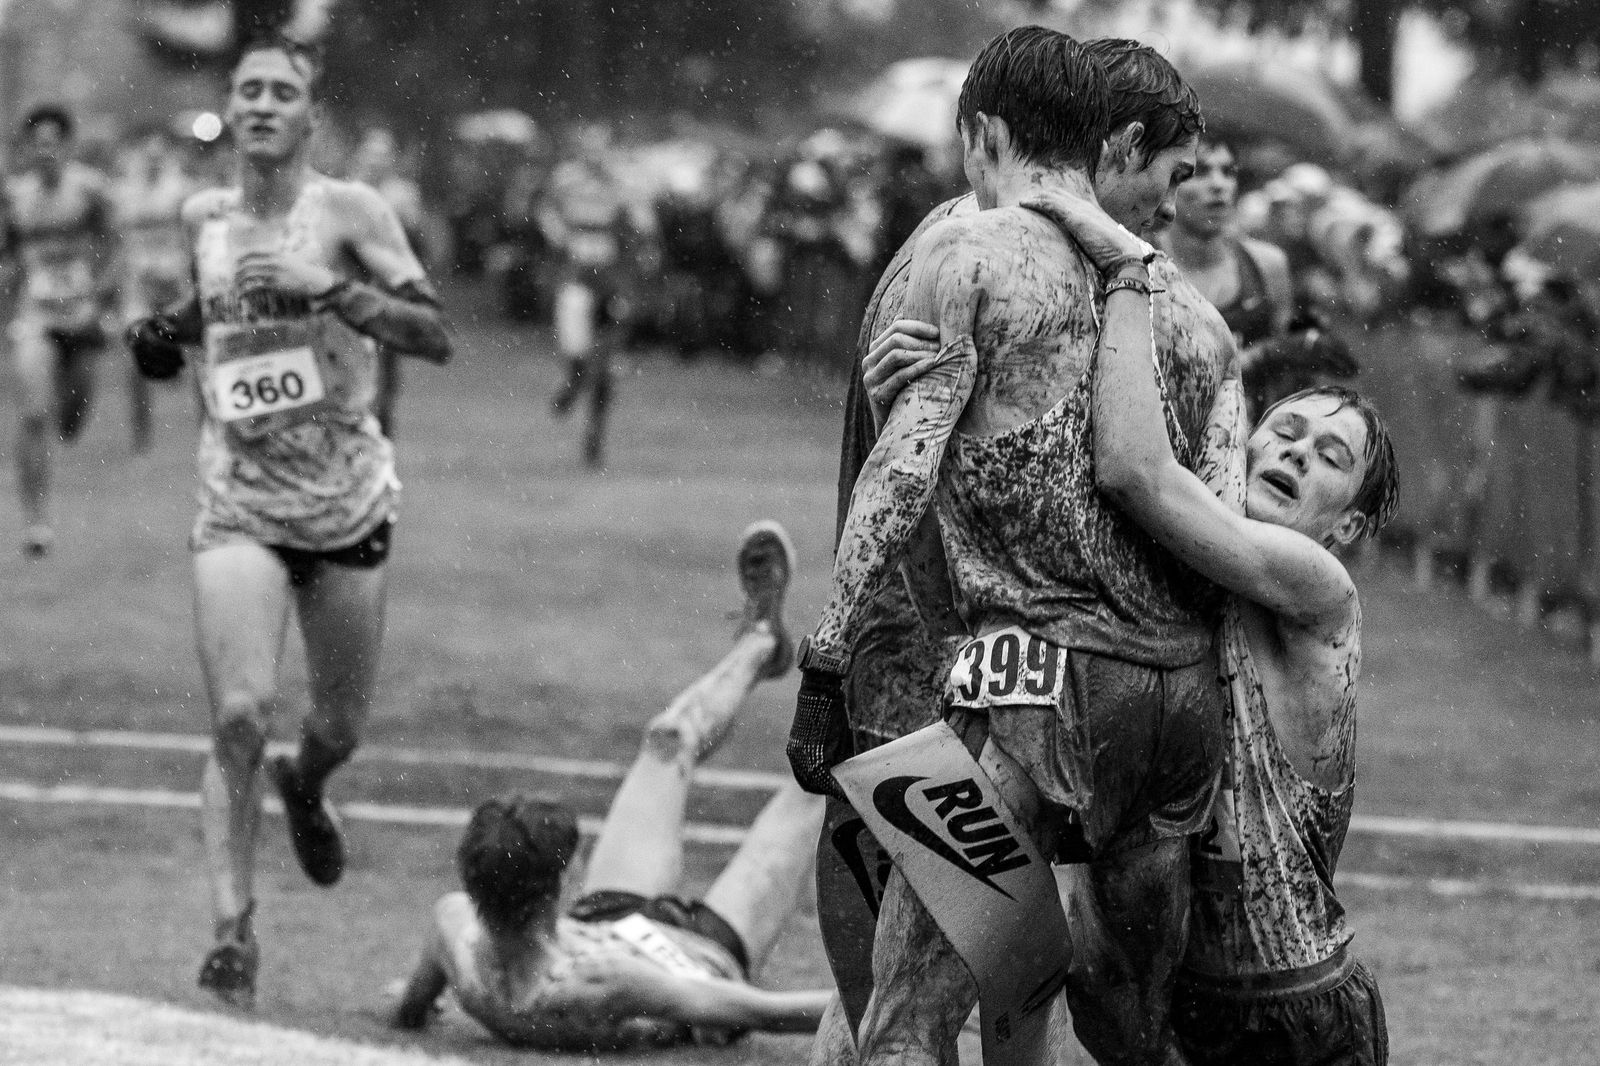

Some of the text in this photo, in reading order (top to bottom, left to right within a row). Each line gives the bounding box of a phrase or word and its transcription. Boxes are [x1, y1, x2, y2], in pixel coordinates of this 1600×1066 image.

[232, 371, 304, 410] 360
[959, 633, 1059, 701] 399
[921, 777, 1032, 878] RUN
